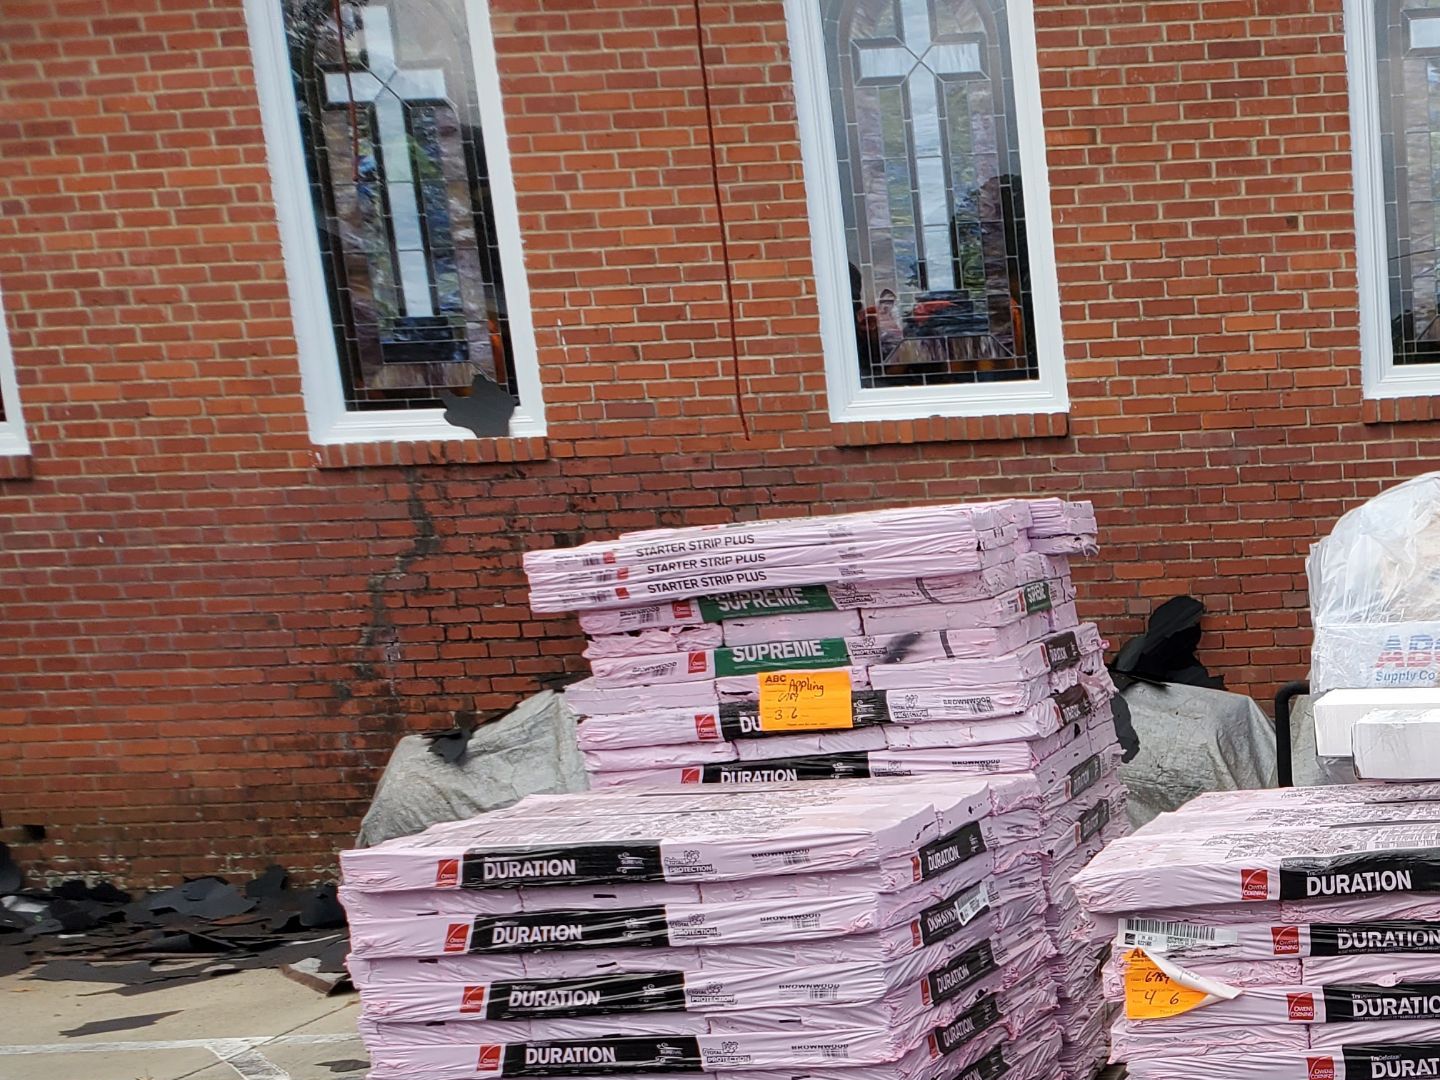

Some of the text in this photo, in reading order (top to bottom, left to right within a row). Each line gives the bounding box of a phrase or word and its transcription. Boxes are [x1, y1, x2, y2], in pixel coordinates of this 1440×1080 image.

[636, 534, 755, 558] STARTER STRIP PLUS
[647, 553, 766, 575] STARTER STRIP PLUS
[647, 571, 767, 594] STARTER STRIP PLUS
[718, 586, 809, 612] SUPREME
[732, 639, 825, 663] SUPREME
[765, 674, 787, 684] ABC
[788, 677, 824, 697] Appling
[1375, 670, 1418, 684] Supply
[721, 769, 798, 783] DURATION
[928, 845, 961, 871] DURATION
[483, 858, 577, 879] DURATION
[669, 865, 713, 873] PROTECTION
[1306, 869, 1413, 897] DURATION
[926, 907, 959, 932] DURATIO
[492, 924, 582, 944] DURATION
[673, 927, 718, 937] PROTECTION
[936, 963, 970, 993] DURATION
[508, 989, 600, 1008] DURATION
[1144, 990, 1180, 1005] 4 6
[943, 1016, 976, 1047] DURATION
[524, 1046, 617, 1065] DURATION
[707, 1055, 750, 1063] PROTECTION
